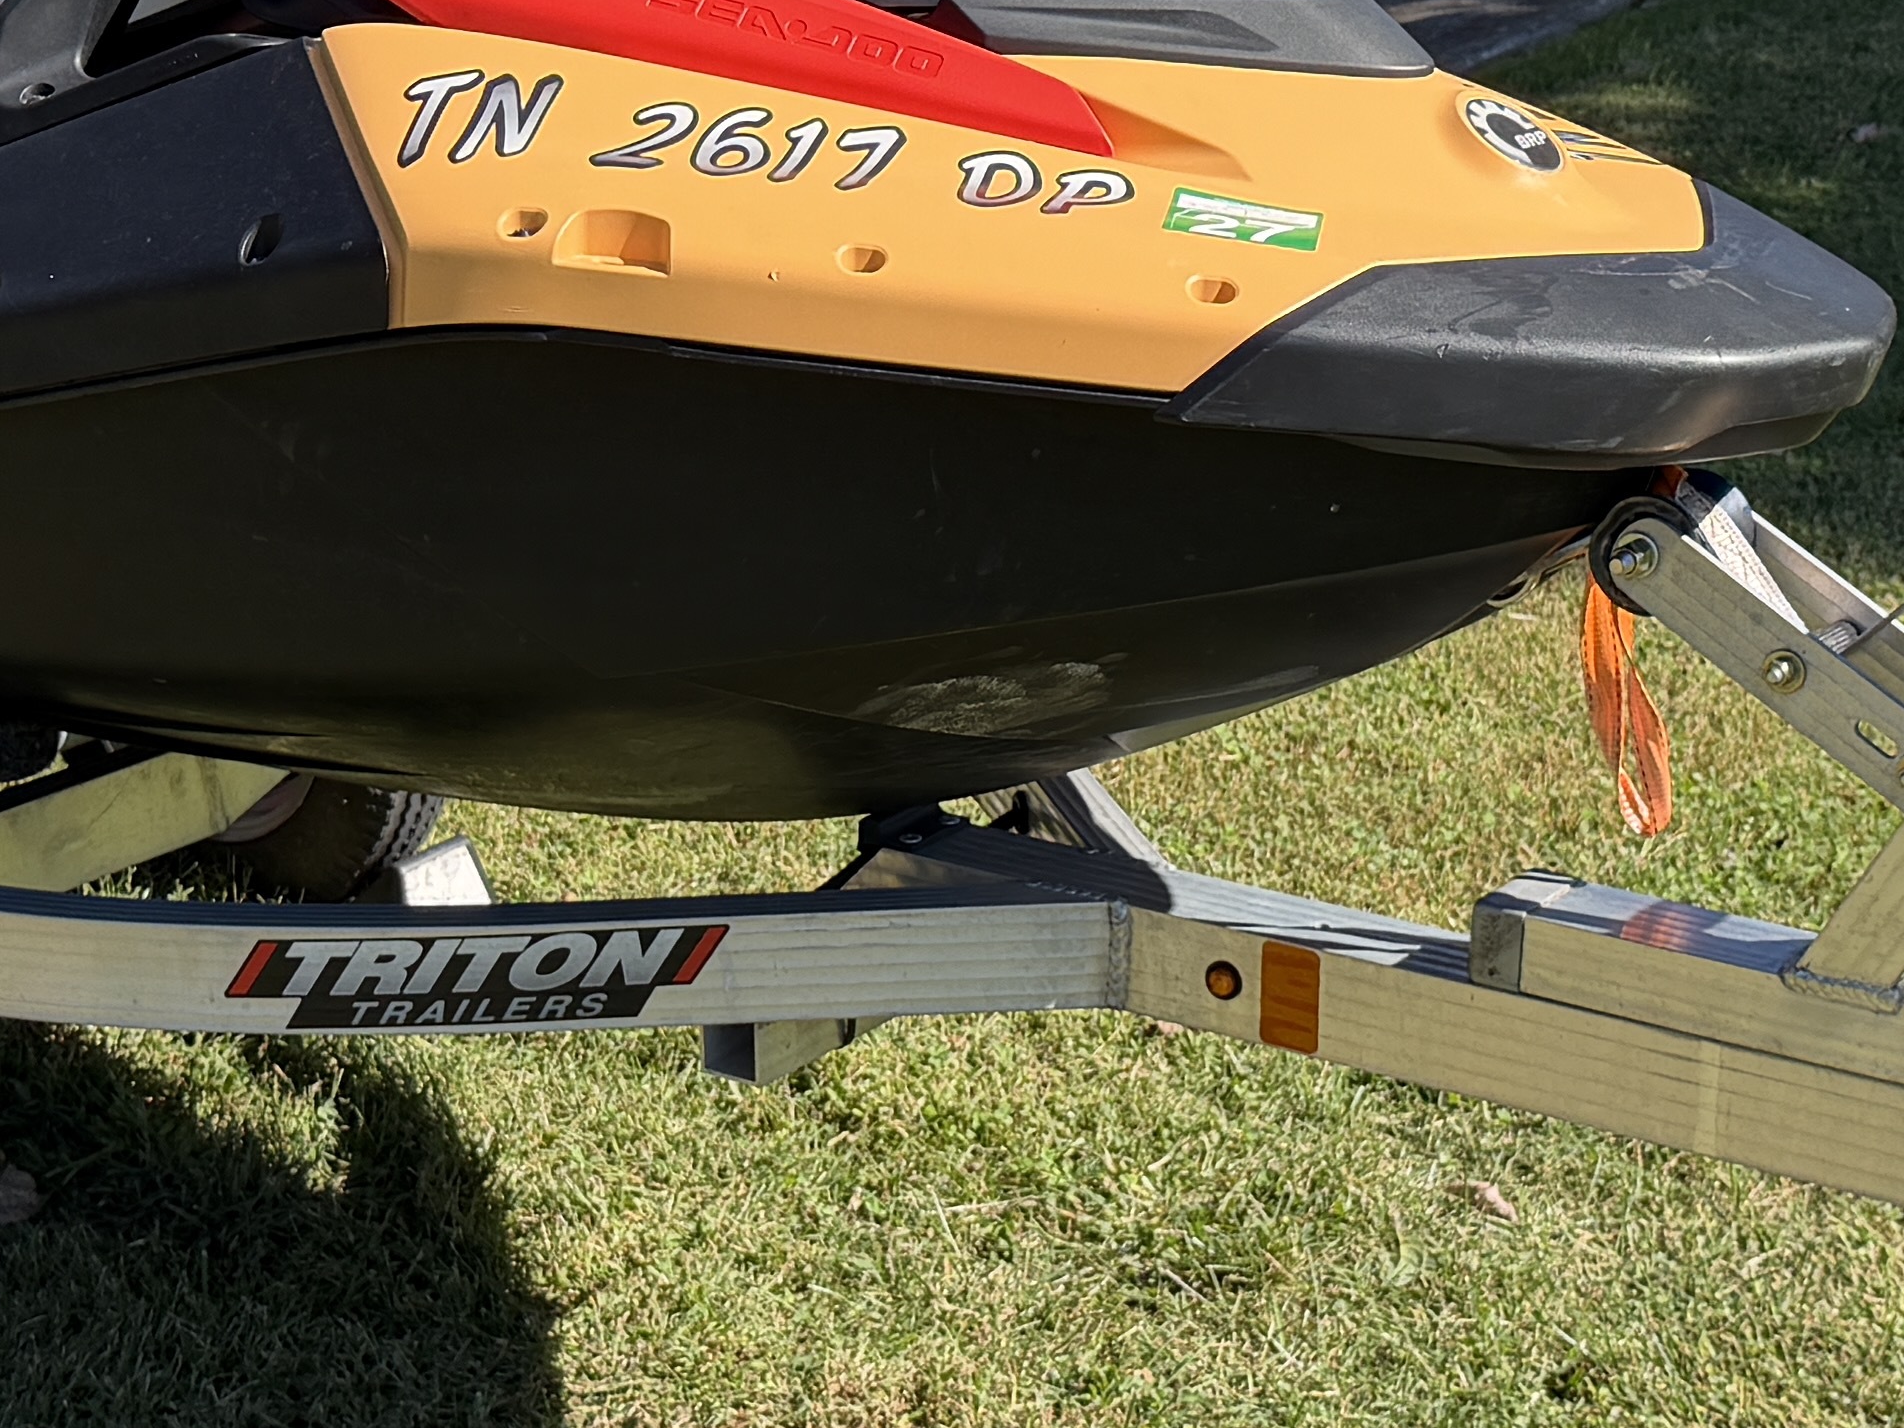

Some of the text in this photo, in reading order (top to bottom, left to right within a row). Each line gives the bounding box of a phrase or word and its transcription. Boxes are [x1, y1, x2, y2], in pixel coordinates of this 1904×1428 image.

[397, 69, 564, 168] TN
[589, 101, 907, 191] 2617
[956, 150, 1135, 214] DP
[1514, 130, 1546, 149] BRP
[1188, 213, 1296, 244] 27
[282, 928, 684, 997] TRITON
[350, 992, 609, 1026] TRAILERS
